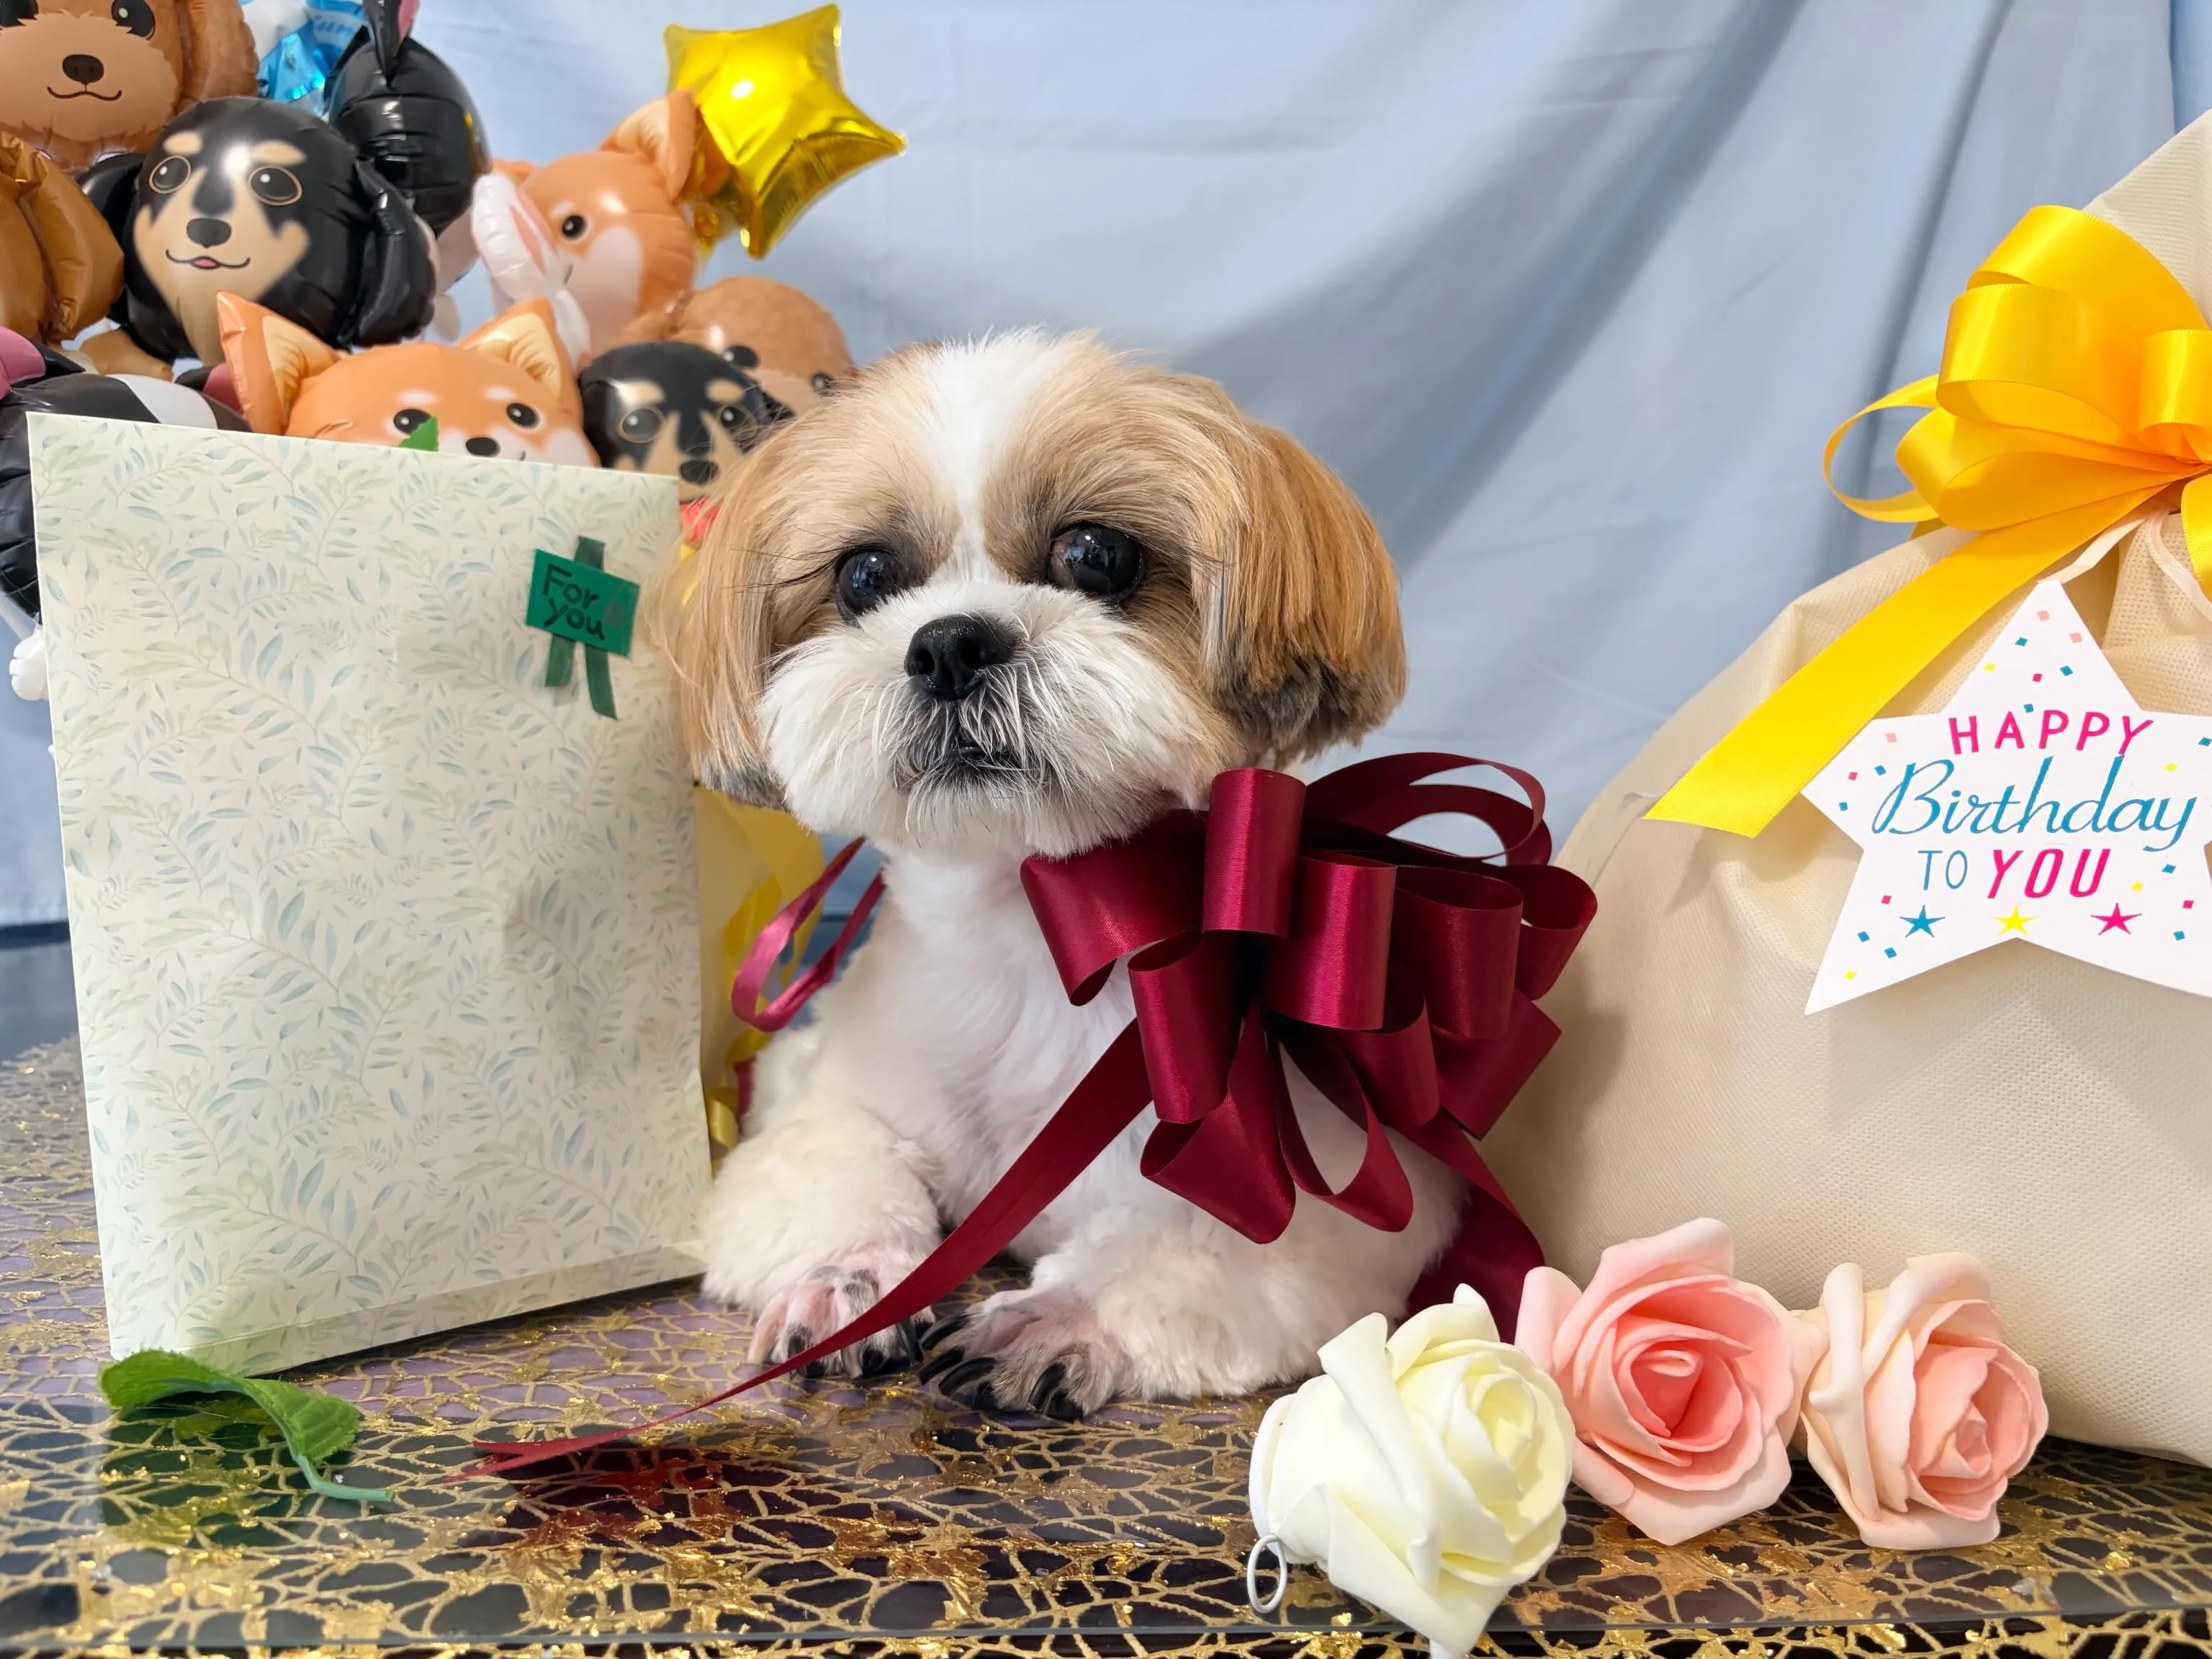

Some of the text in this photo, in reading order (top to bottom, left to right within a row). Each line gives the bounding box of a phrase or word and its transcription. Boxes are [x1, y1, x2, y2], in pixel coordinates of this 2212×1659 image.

[543, 563, 600, 609] For
[1948, 710, 2154, 755] HAPPY
[1872, 755, 2197, 853] Birthday
[1917, 848, 2110, 899] TO YOU
